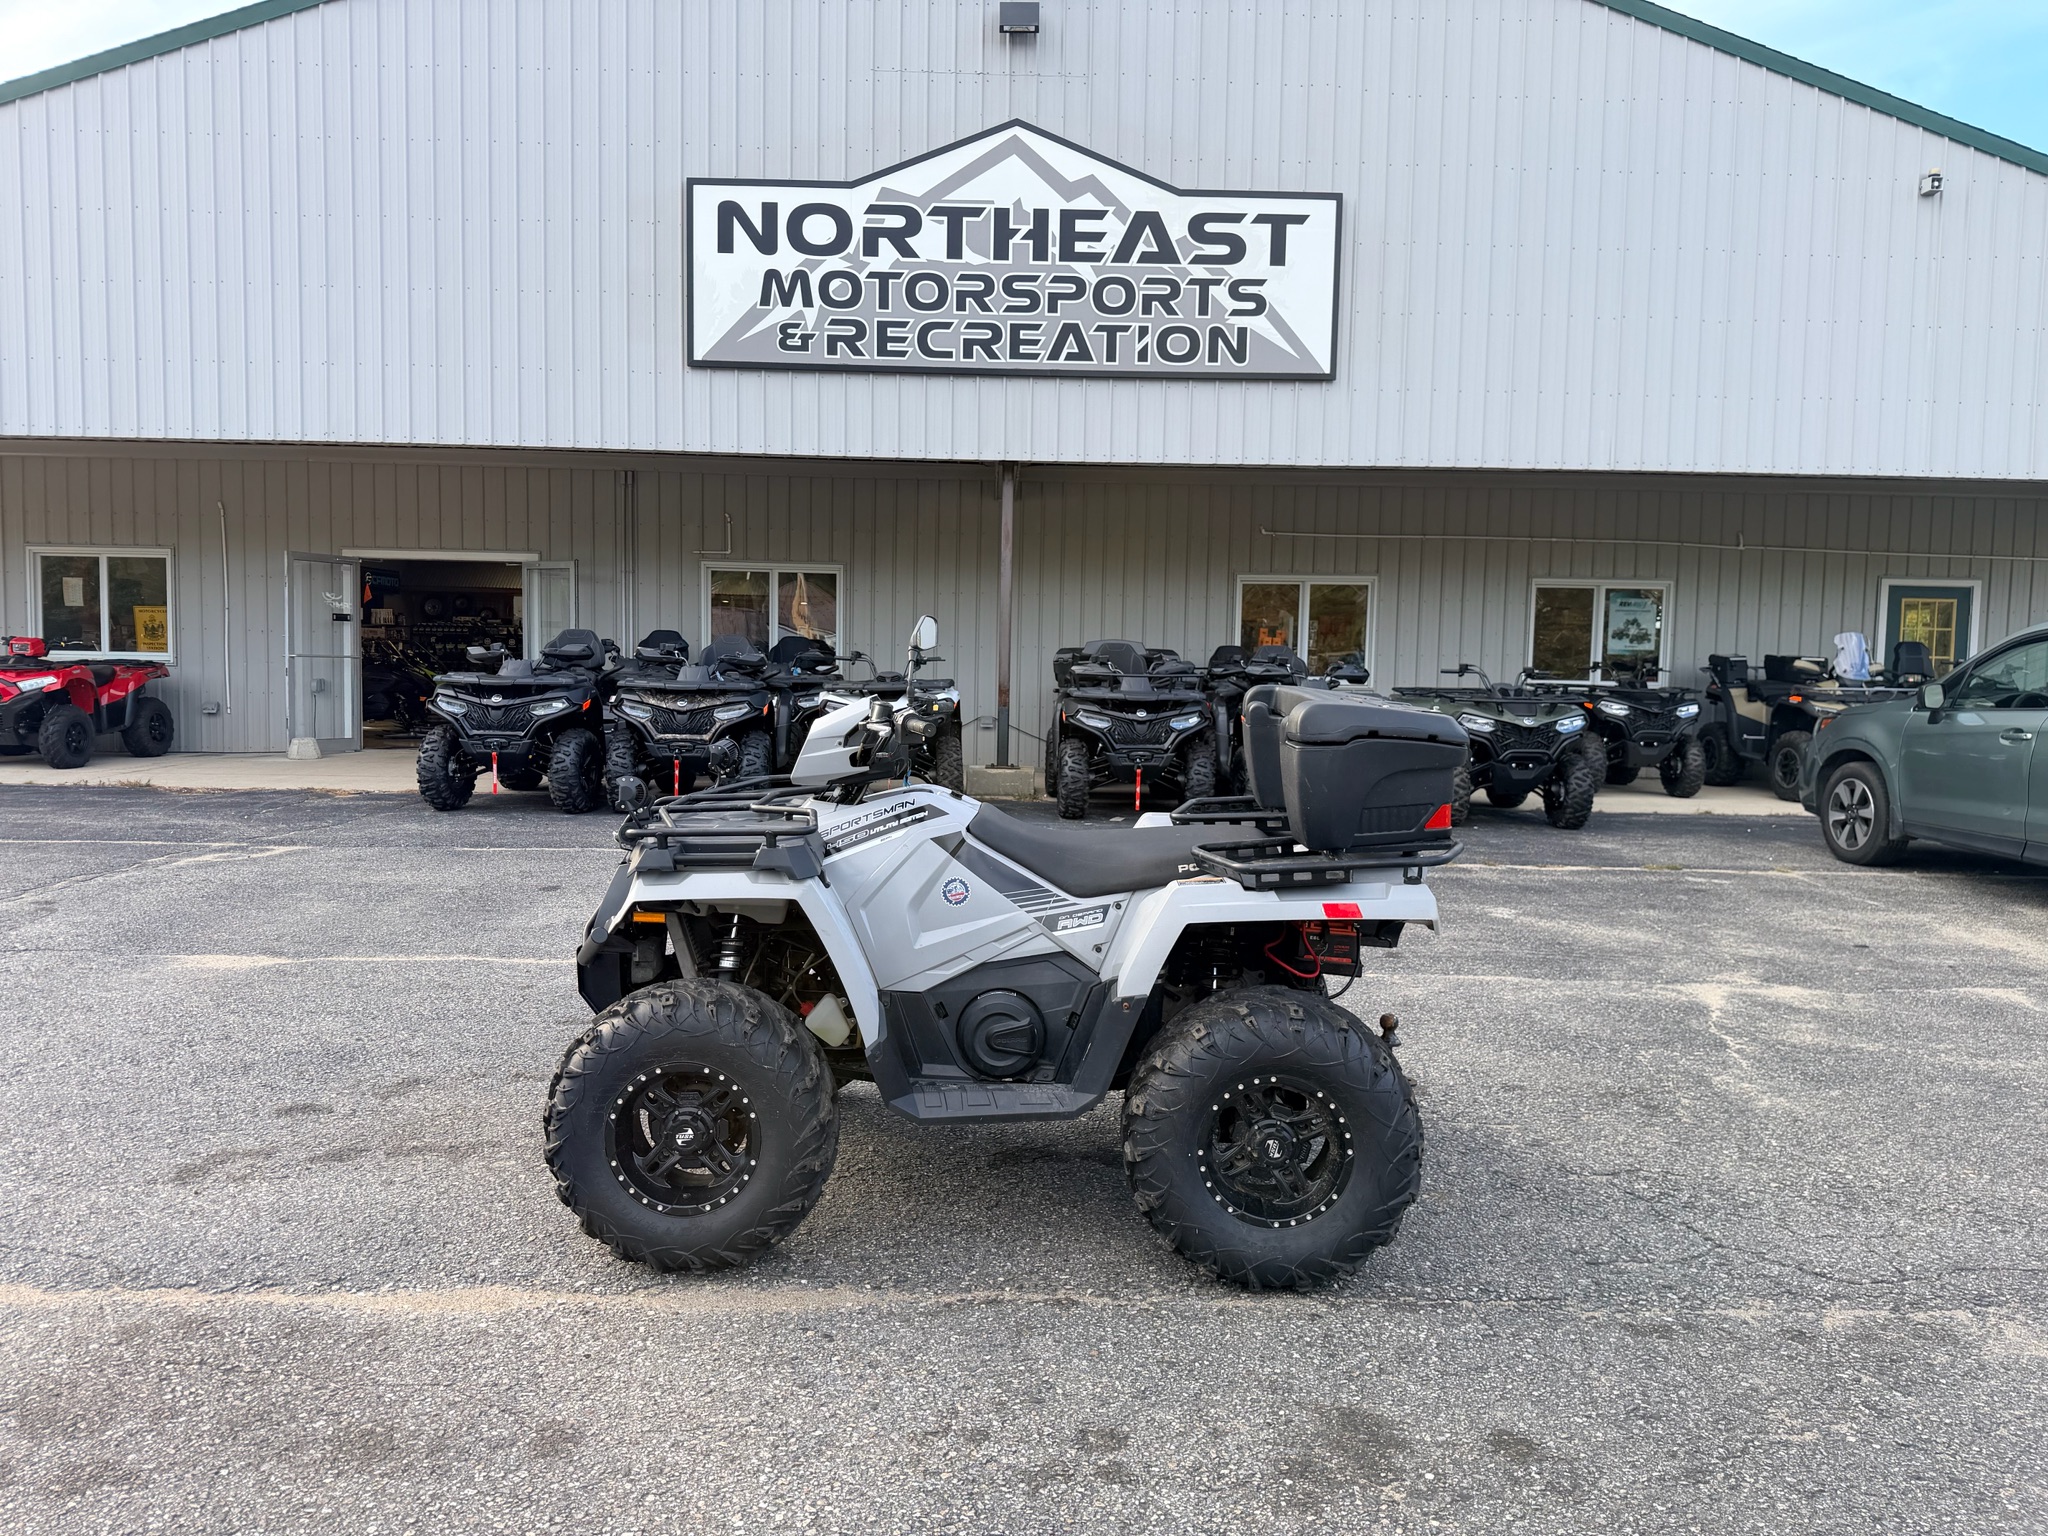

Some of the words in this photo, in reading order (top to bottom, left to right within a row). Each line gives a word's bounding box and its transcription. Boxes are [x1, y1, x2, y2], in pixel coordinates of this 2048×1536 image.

[716, 200, 1310, 266] NORTHEAST
[758, 269, 1267, 317] MOTORSPORTS
[826, 318, 1248, 364] RECREATION
[820, 799, 916, 838] SPORTSMAN
[869, 819, 899, 836] UTILITY
[899, 810, 929, 825] EDITION
[1057, 913, 1104, 930] AWD
[1072, 908, 1104, 917] DEMAND
